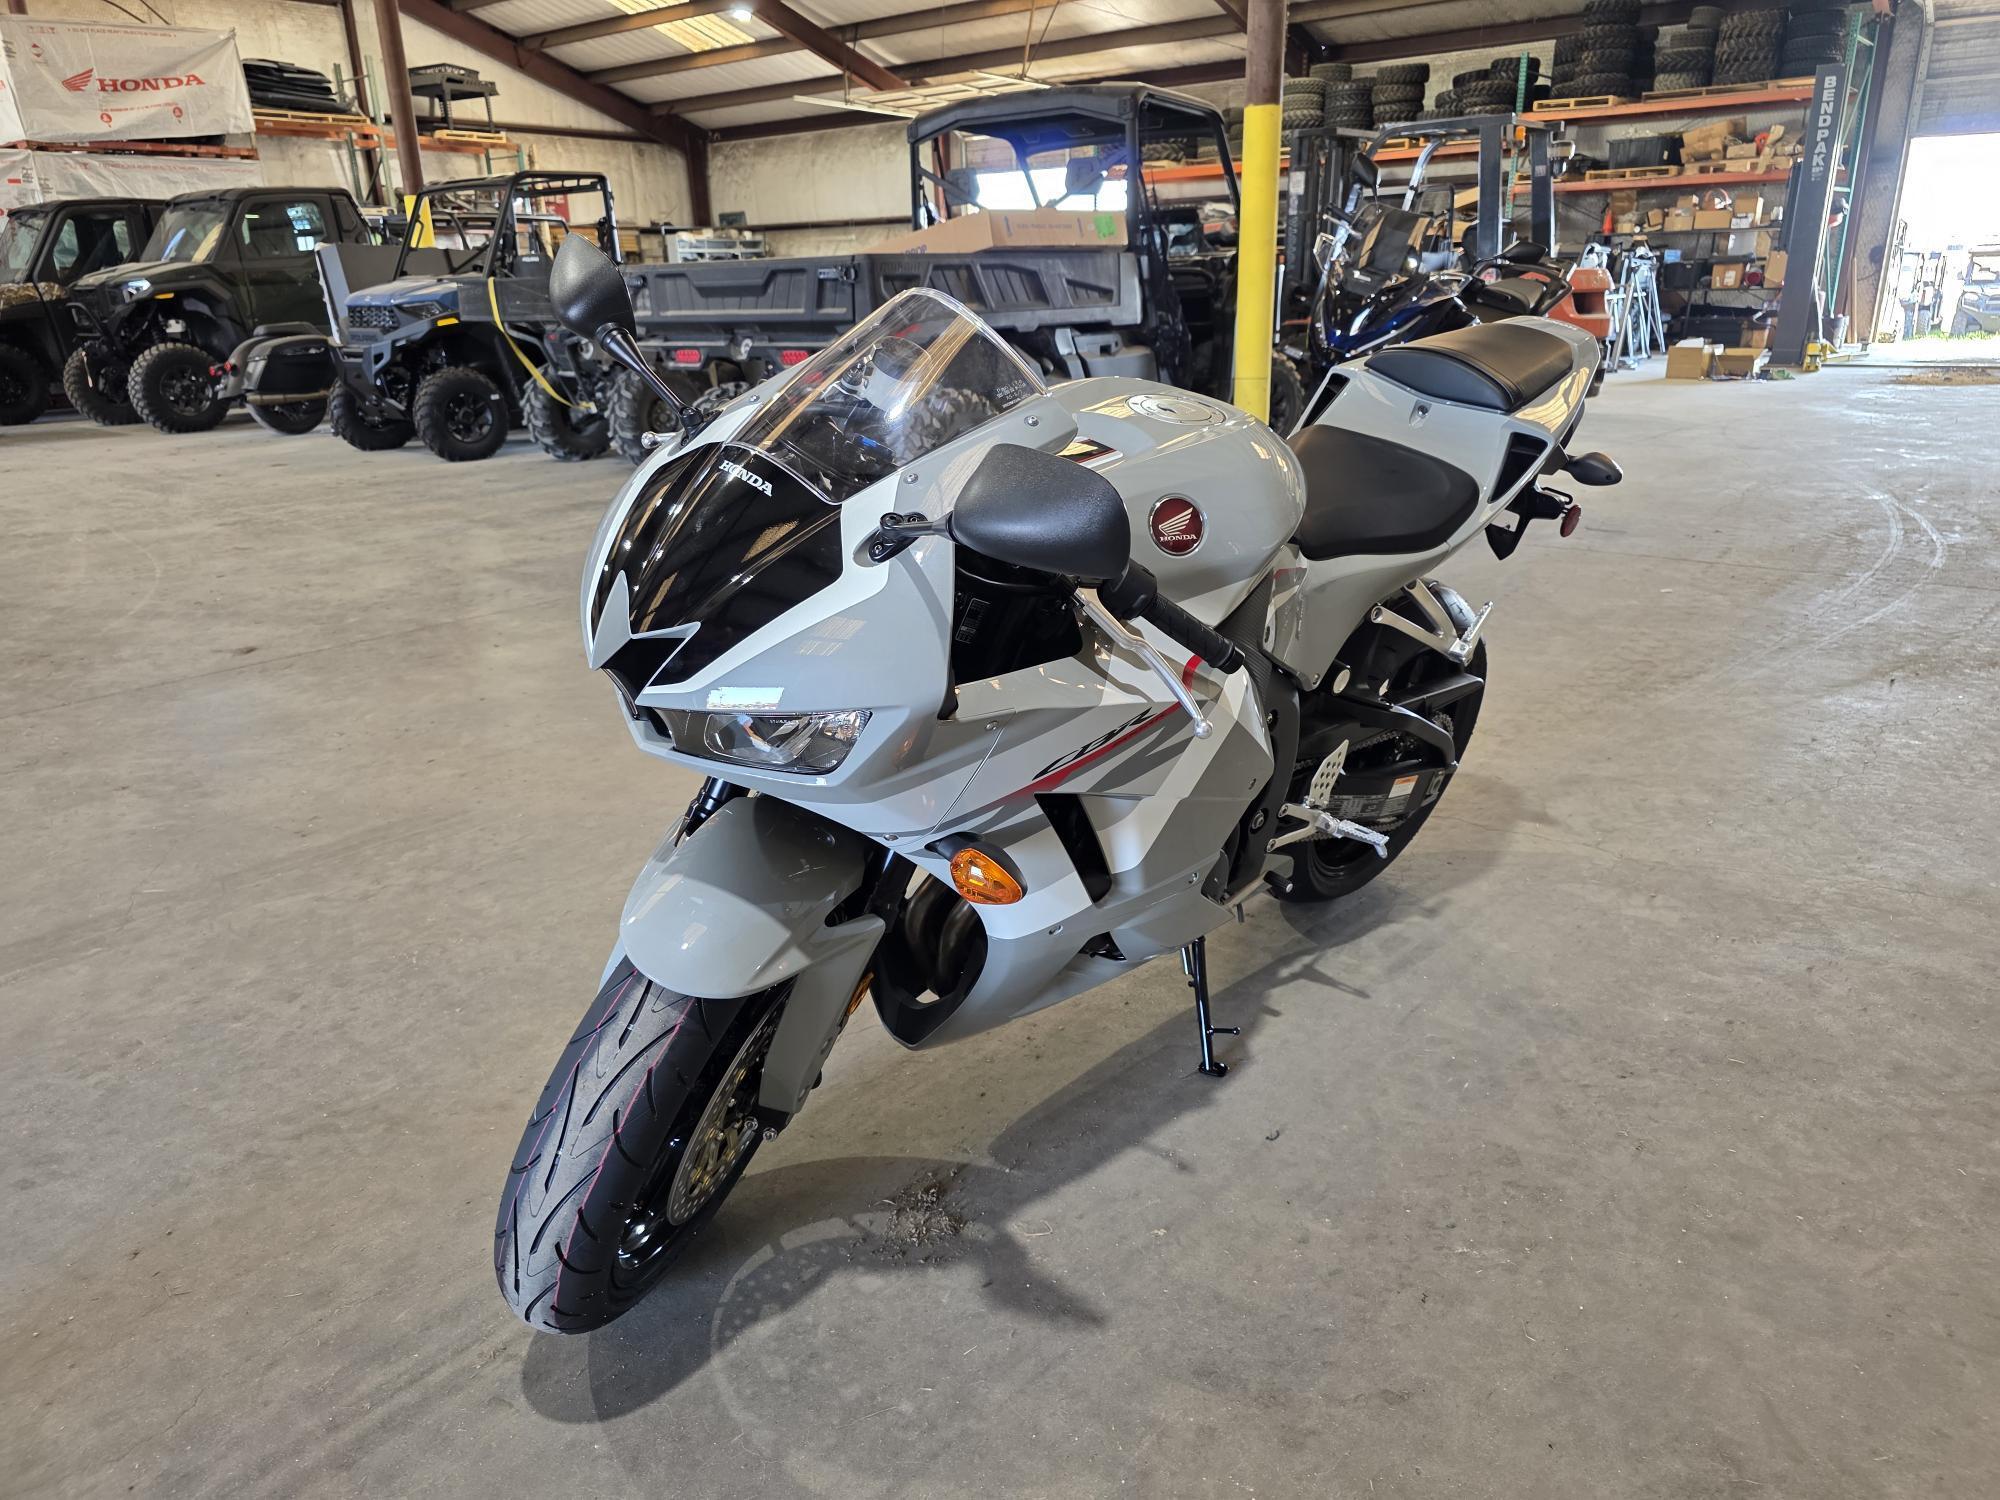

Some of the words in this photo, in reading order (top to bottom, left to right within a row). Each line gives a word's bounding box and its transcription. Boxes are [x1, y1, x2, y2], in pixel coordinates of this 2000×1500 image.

[98, 74, 206, 92] HONDA
[1812, 76, 1837, 166] BENDPAK
[719, 460, 772, 497] HONDA
[1160, 534, 1197, 542] HONDA
